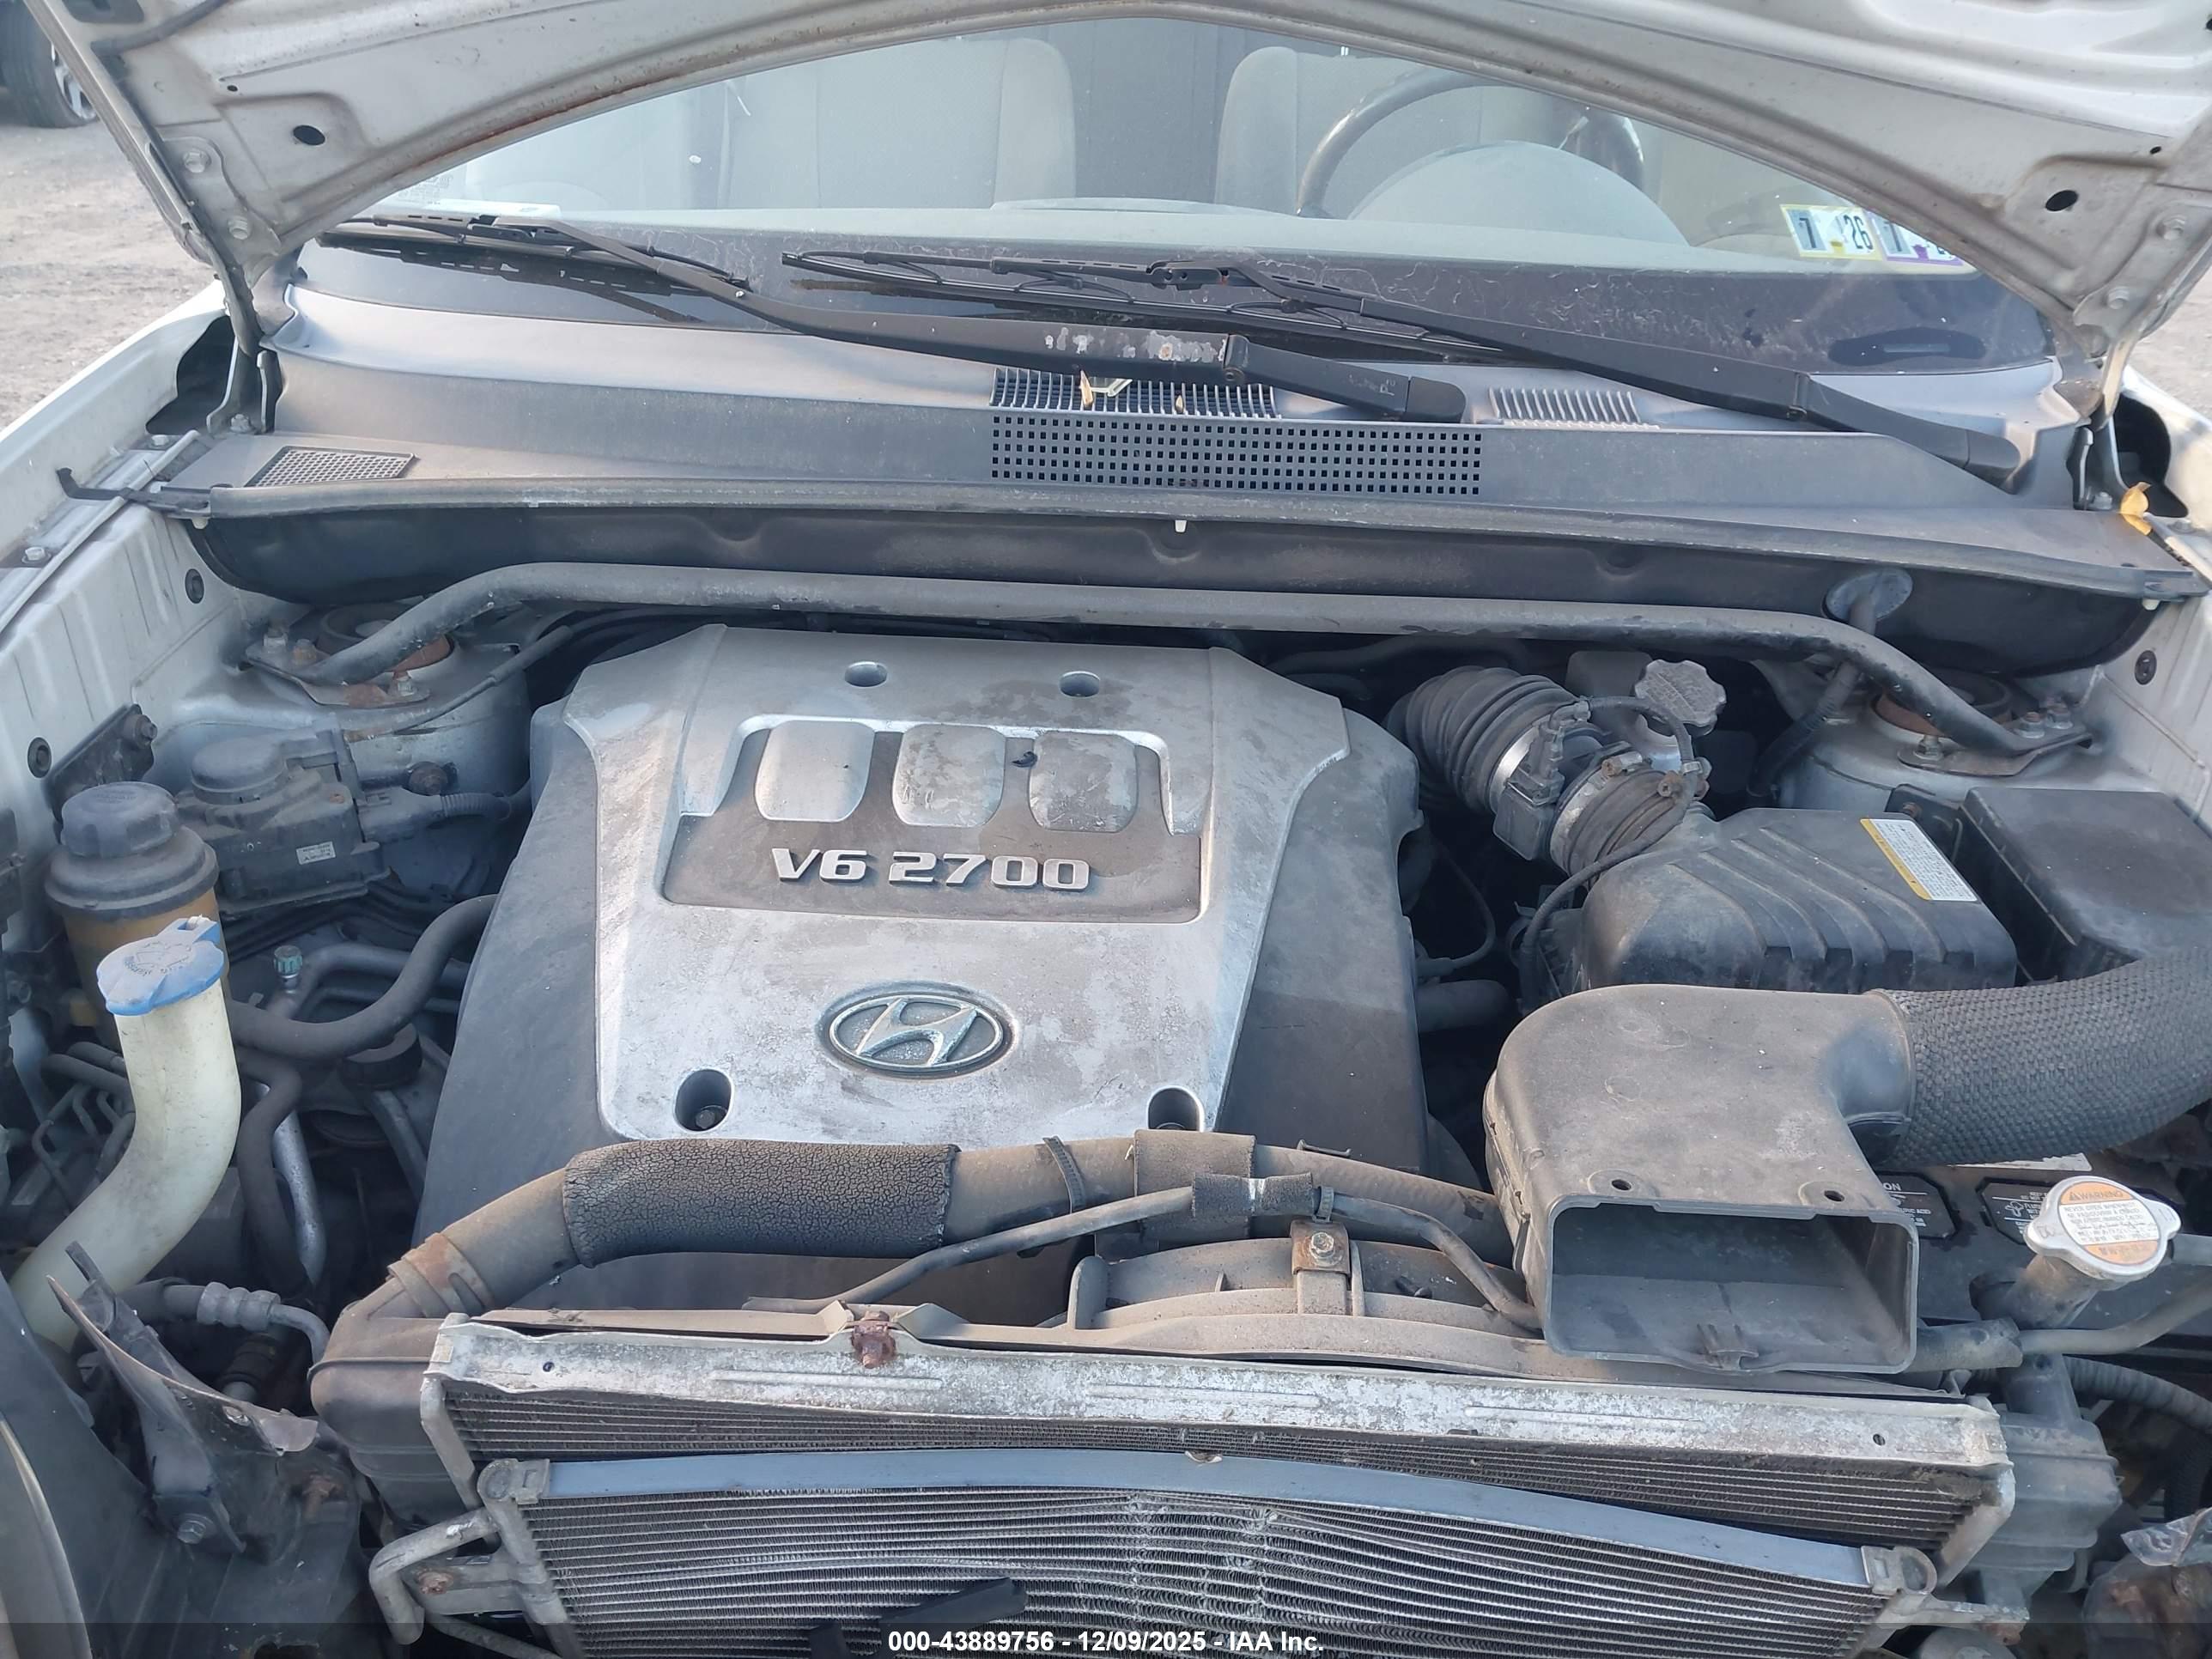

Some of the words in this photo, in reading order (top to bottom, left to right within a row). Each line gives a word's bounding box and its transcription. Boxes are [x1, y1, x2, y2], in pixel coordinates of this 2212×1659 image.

[1844, 215, 1874, 250] 26
[772, 848, 867, 883] V6
[888, 850, 1091, 891] 2700
[2080, 1190, 2124, 1200] WARNING
